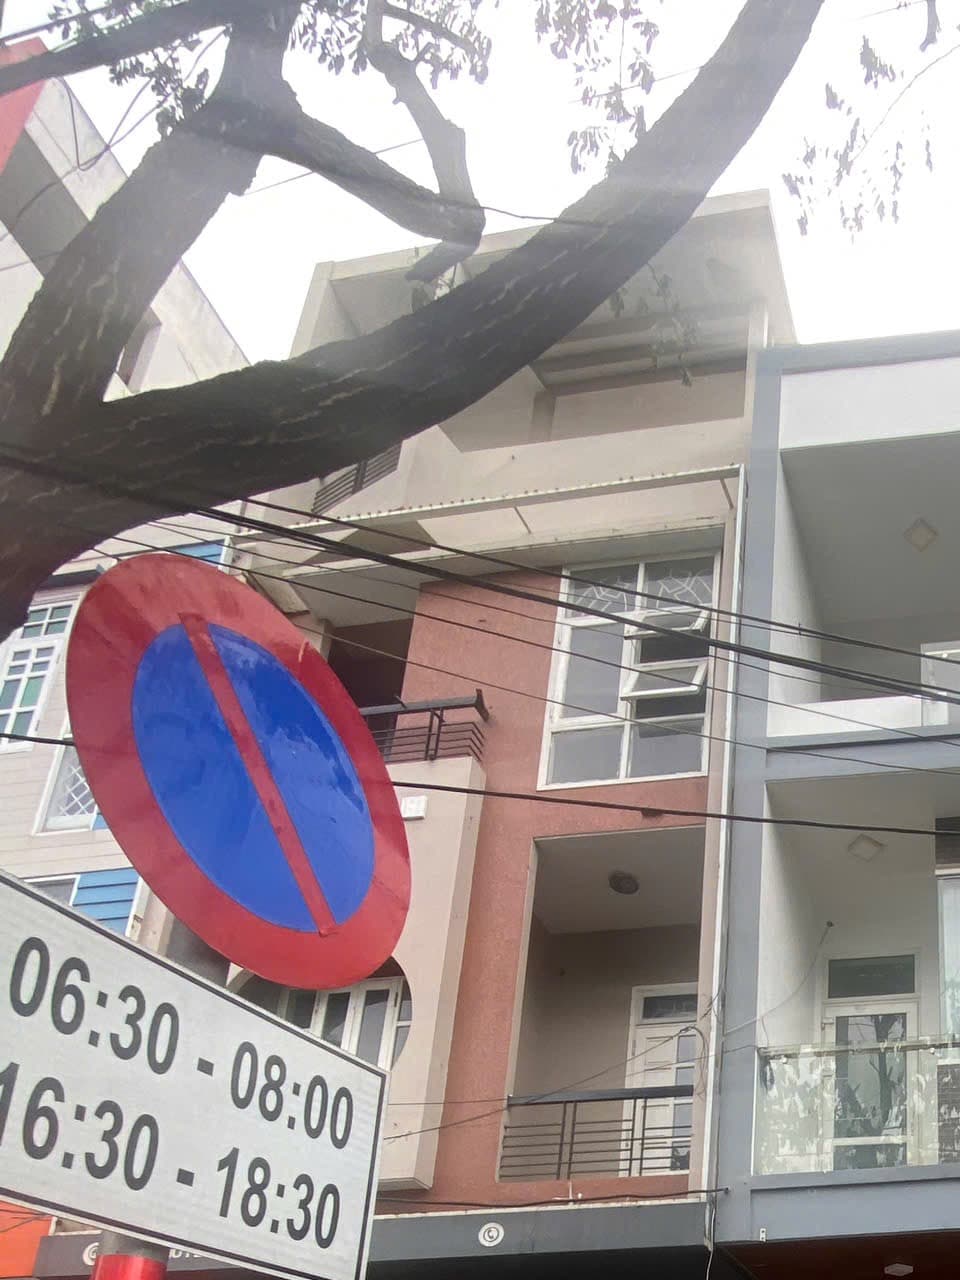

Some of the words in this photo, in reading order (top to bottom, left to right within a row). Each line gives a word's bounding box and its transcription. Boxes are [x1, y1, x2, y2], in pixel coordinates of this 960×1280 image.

[10, 937, 179, 1075] 06:30
[230, 1041, 354, 1149] 08:00
[0, 1062, 159, 1191] 16:30
[216, 1147, 340, 1249] 18:30
